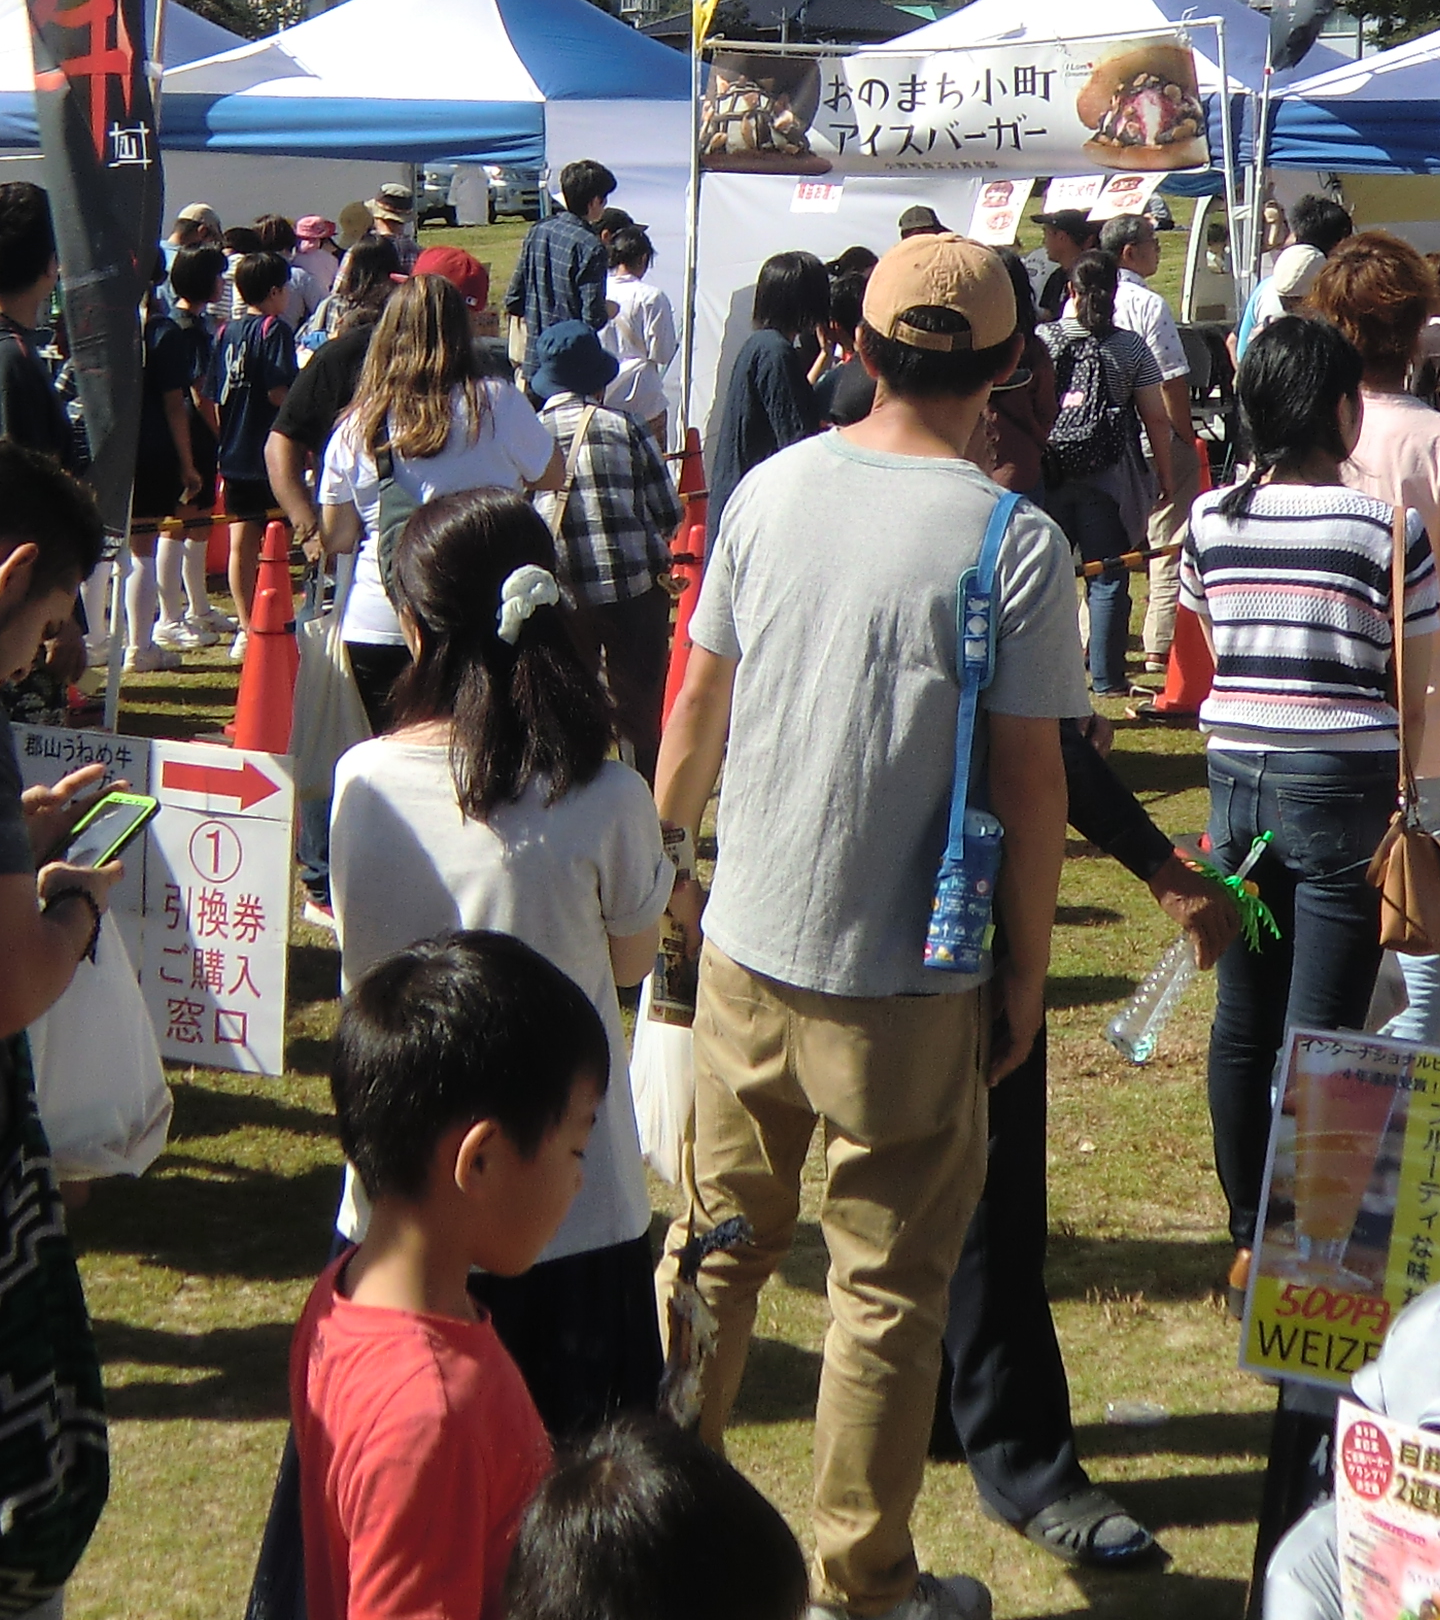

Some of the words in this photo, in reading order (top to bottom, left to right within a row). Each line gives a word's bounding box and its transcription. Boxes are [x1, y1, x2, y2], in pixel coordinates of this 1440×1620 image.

[822, 65, 1058, 113] おのまち小町
[828, 113, 1048, 157] アイスバーガー
[24, 733, 133, 769] 郡山うねめ牛
[163, 883, 266, 944] 引換券
[158, 944, 262, 999] ご購入
[165, 997, 249, 1048] 窓口
[1275, 1283, 1392, 1336] 500円
